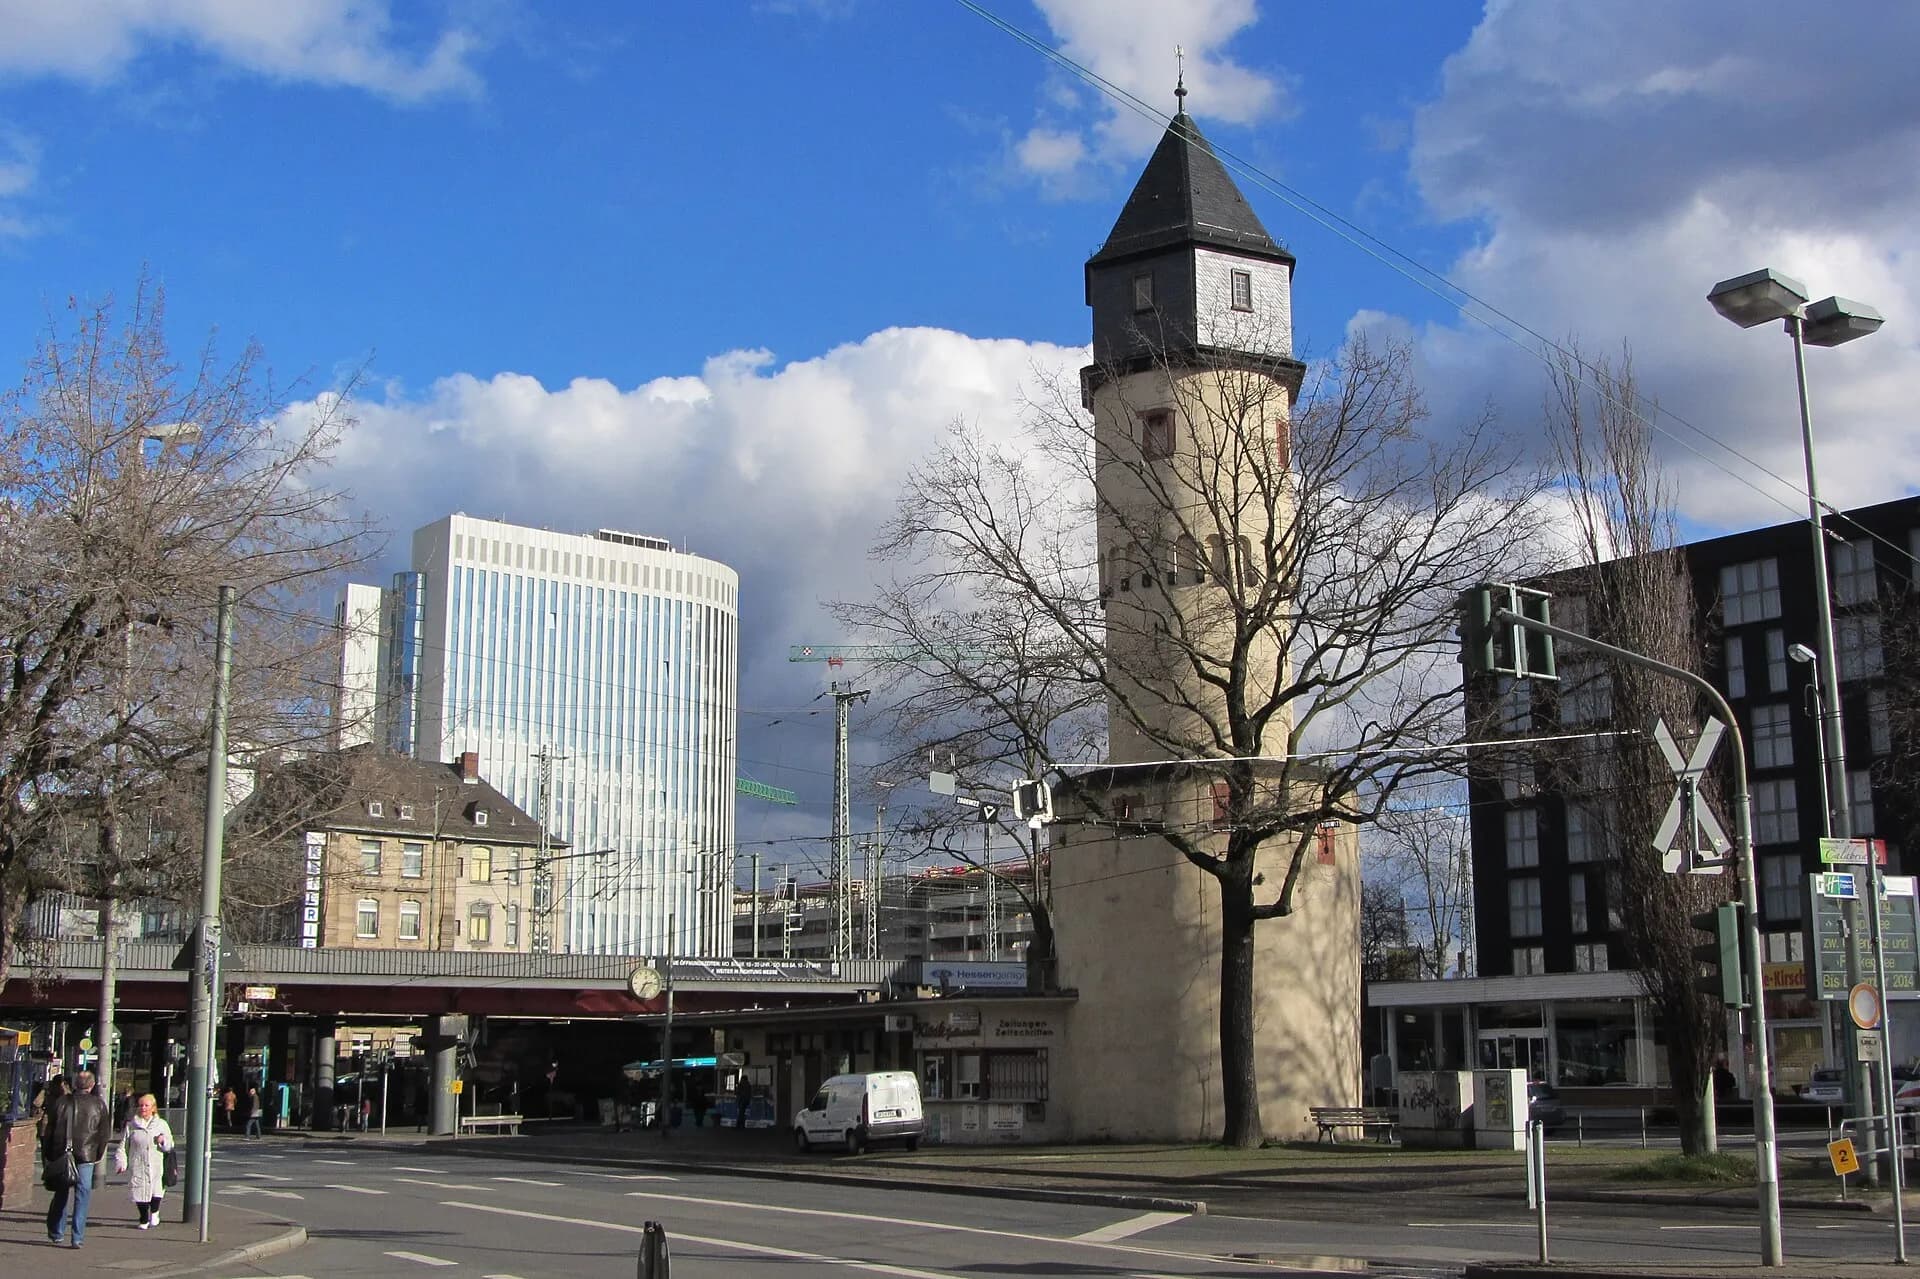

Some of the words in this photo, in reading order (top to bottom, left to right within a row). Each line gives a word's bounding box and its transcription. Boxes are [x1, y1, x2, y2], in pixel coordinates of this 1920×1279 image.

[1892, 936, 1909, 948] und
[1823, 974, 1840, 988] Bis
[1892, 975, 1914, 988] 2014
[999, 1019, 1048, 1029] Zeitungen
[995, 1028, 1054, 1037] Zeitschriften
[1838, 1149, 1849, 1163] 2
